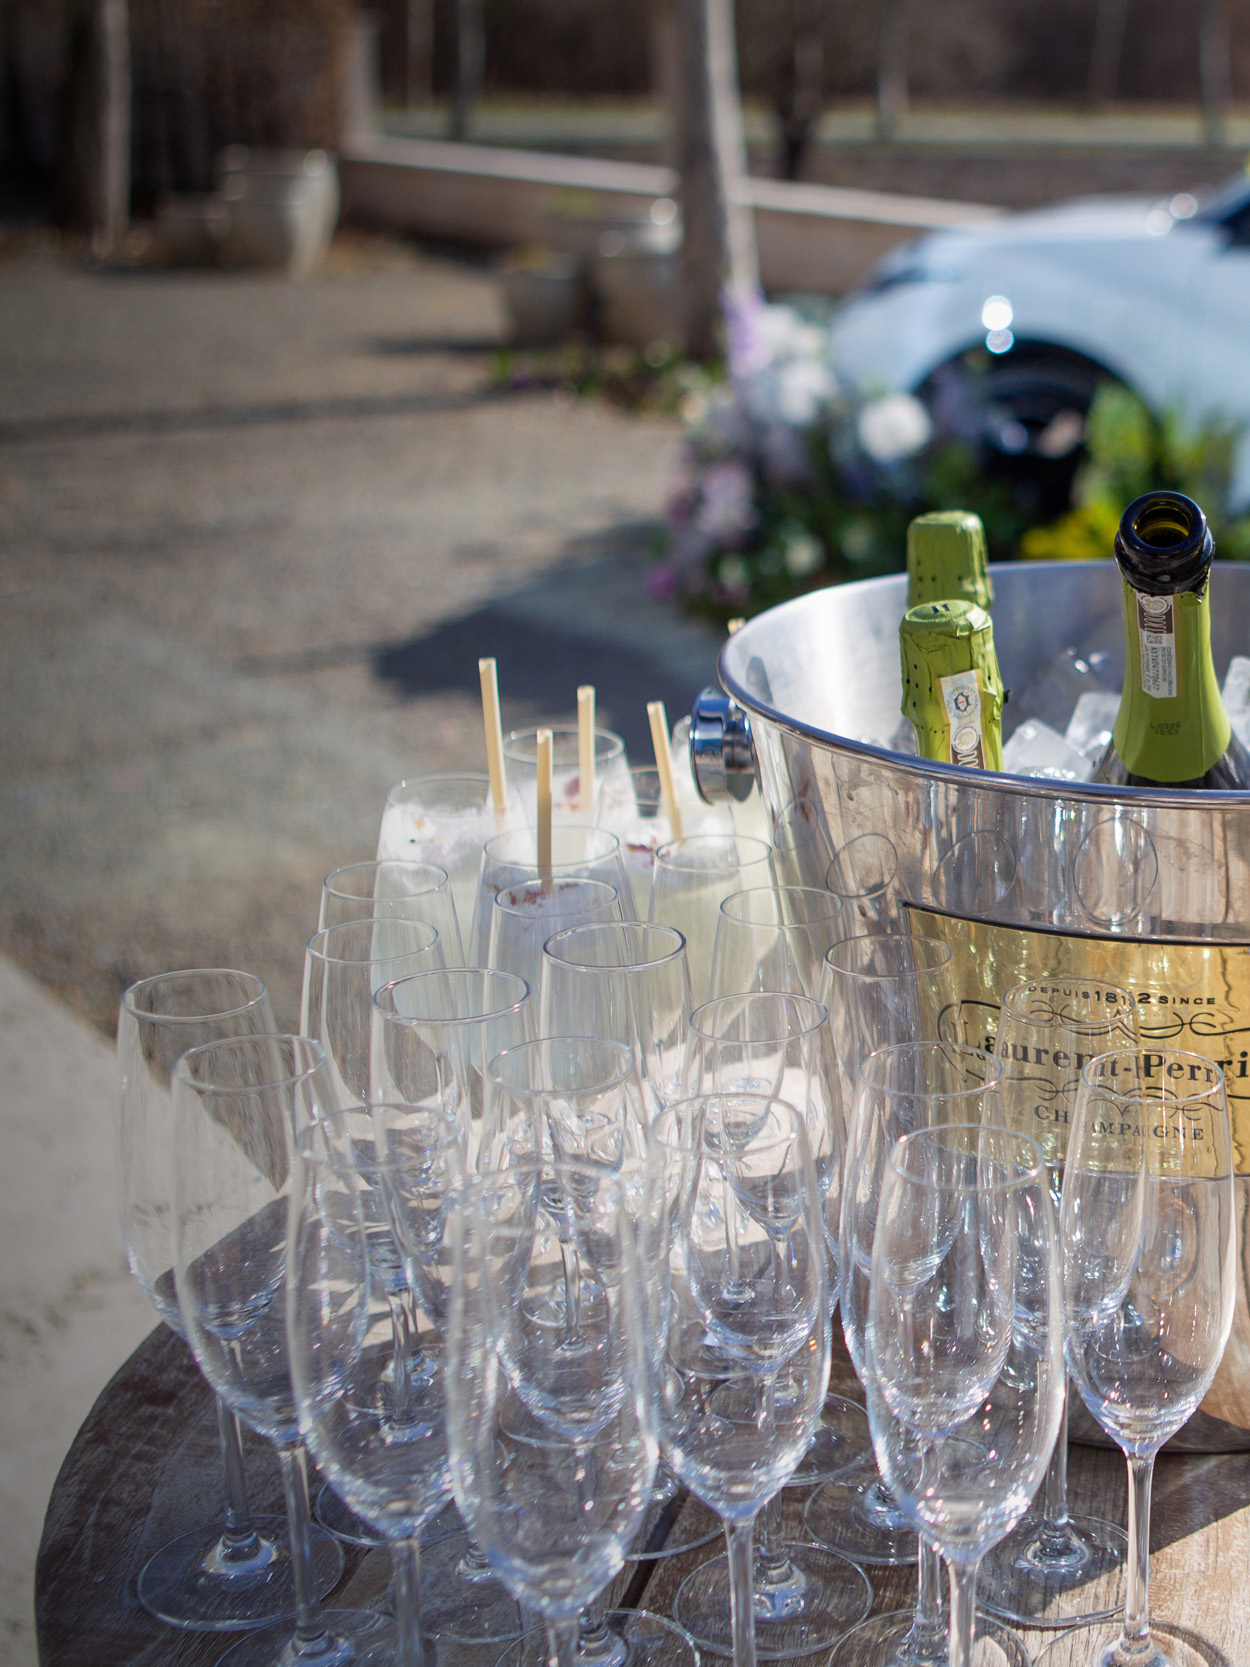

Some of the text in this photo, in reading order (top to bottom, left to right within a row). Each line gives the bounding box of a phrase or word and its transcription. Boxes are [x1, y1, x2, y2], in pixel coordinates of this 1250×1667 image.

[1028, 986, 1091, 1000] DEPUIS
[1158, 994, 1216, 1006] SINCE
[1033, 1104, 1205, 1141] CHAMPAGNE
